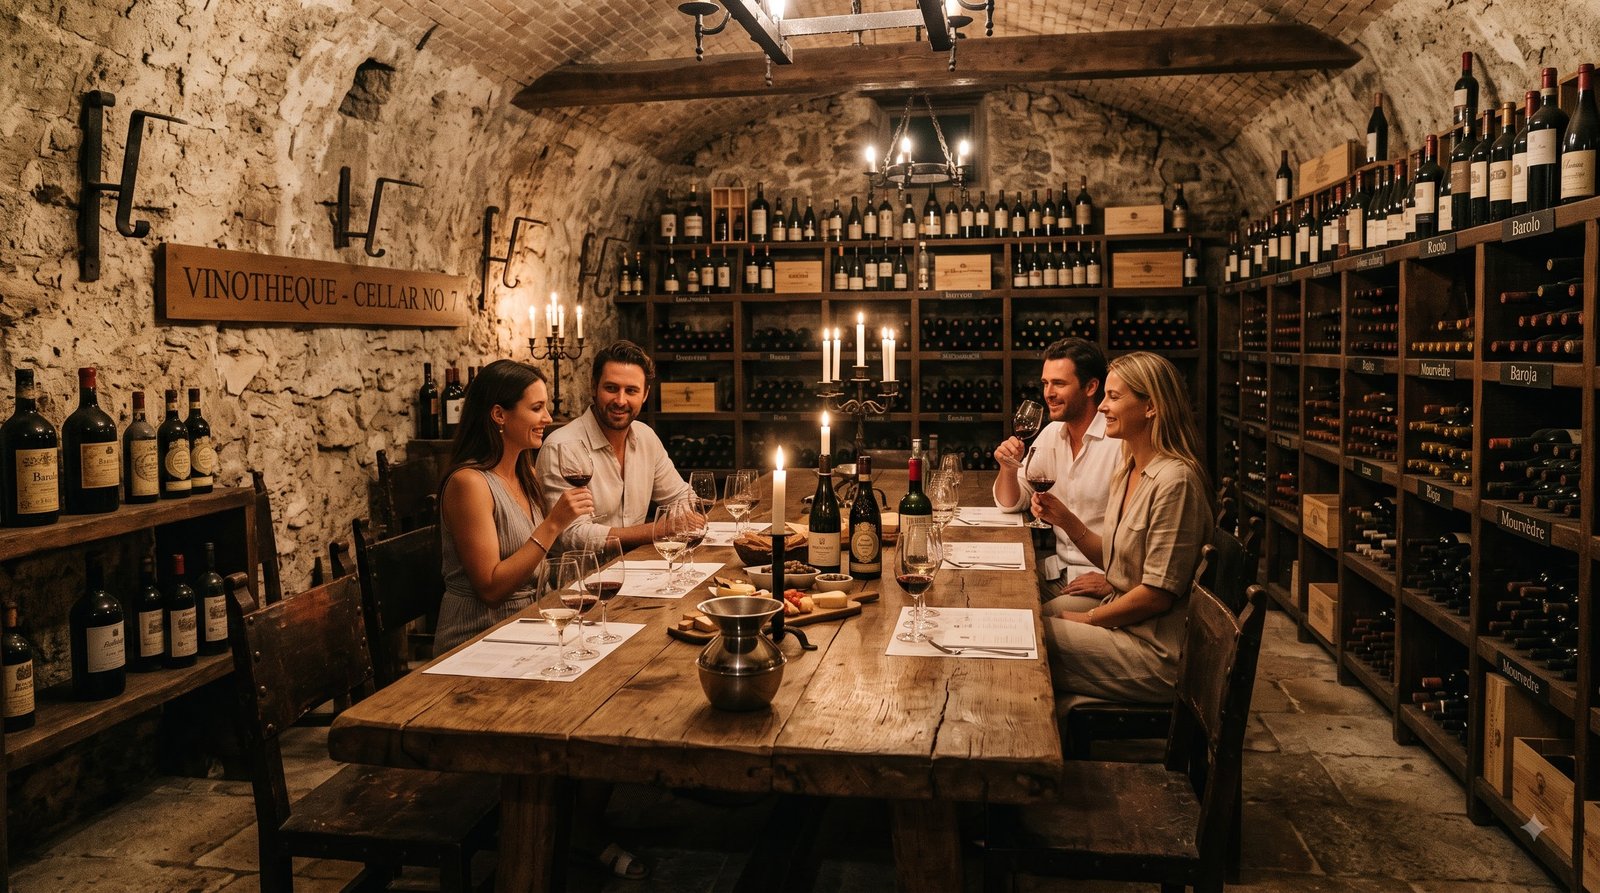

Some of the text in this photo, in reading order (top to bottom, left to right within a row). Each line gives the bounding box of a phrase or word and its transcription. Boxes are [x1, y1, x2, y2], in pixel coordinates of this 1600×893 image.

[1512, 215, 1541, 236] Barolo
[182, 266, 338, 310] VINOTHEQUE
[353, 281, 419, 310] CELLAR
[423, 288, 447, 312] NO.
[451, 290, 458, 311] 7
[1510, 365, 1537, 385] Baroja
[1501, 510, 1545, 540] Mourvèdre
